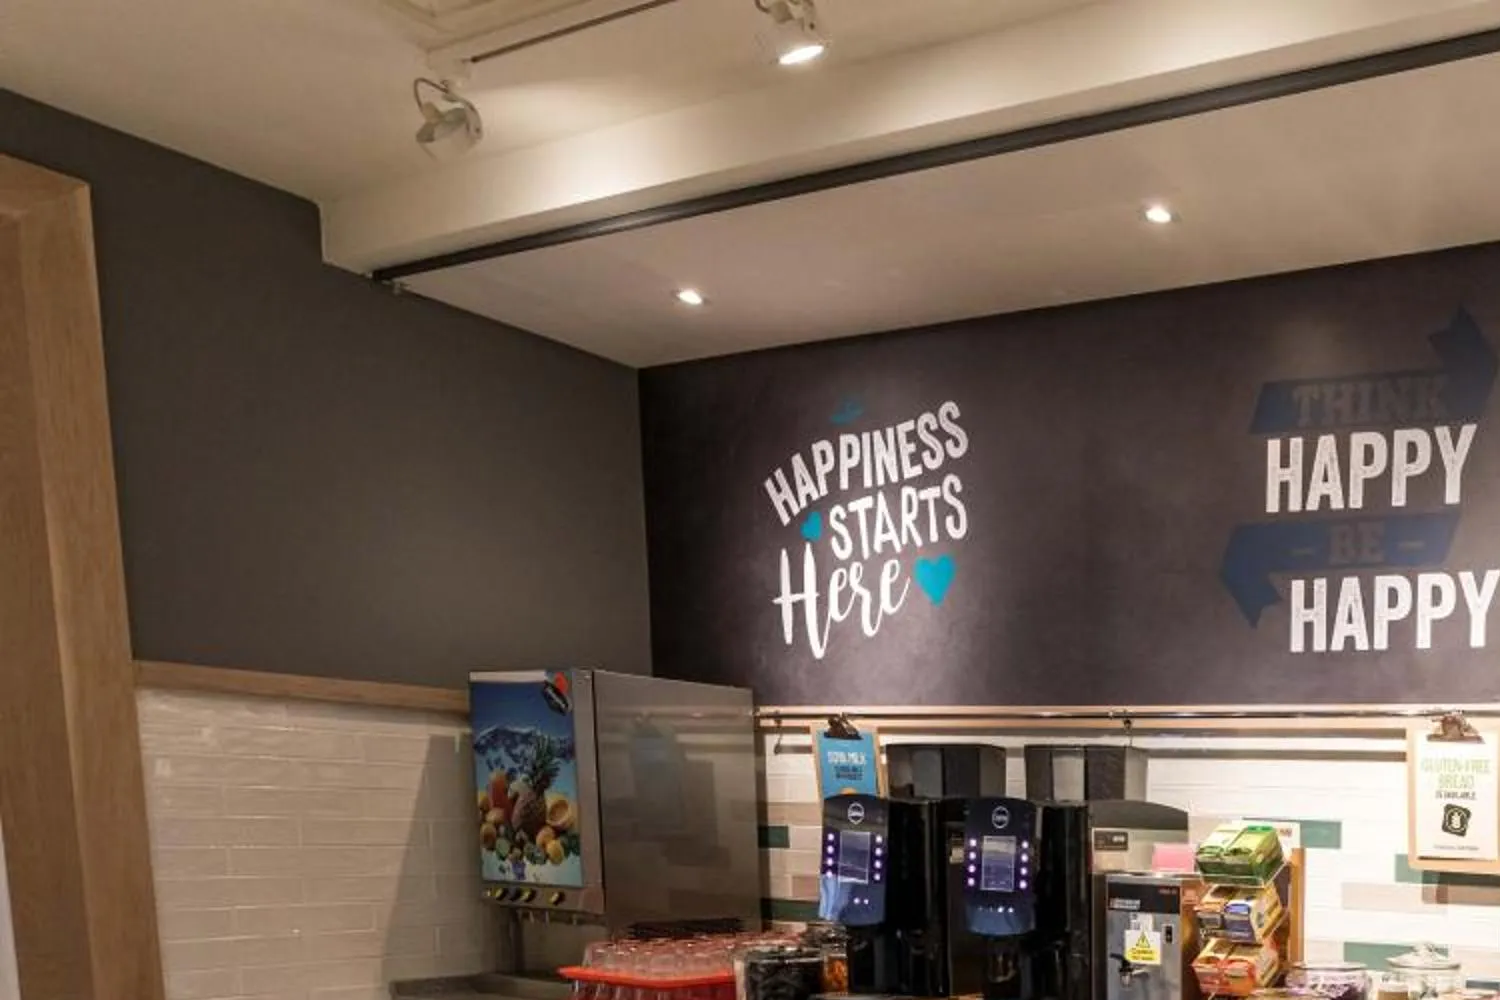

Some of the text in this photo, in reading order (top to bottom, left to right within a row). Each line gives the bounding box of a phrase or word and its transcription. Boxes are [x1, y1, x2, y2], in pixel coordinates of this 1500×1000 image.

[1291, 374, 1449, 428] THINK
[763, 400, 969, 527] HAPPINESS
[1265, 423, 1478, 514] HAPPY
[828, 473, 969, 561] STARTS
[1328, 520, 1386, 566] BE
[772, 541, 911, 660] Here
